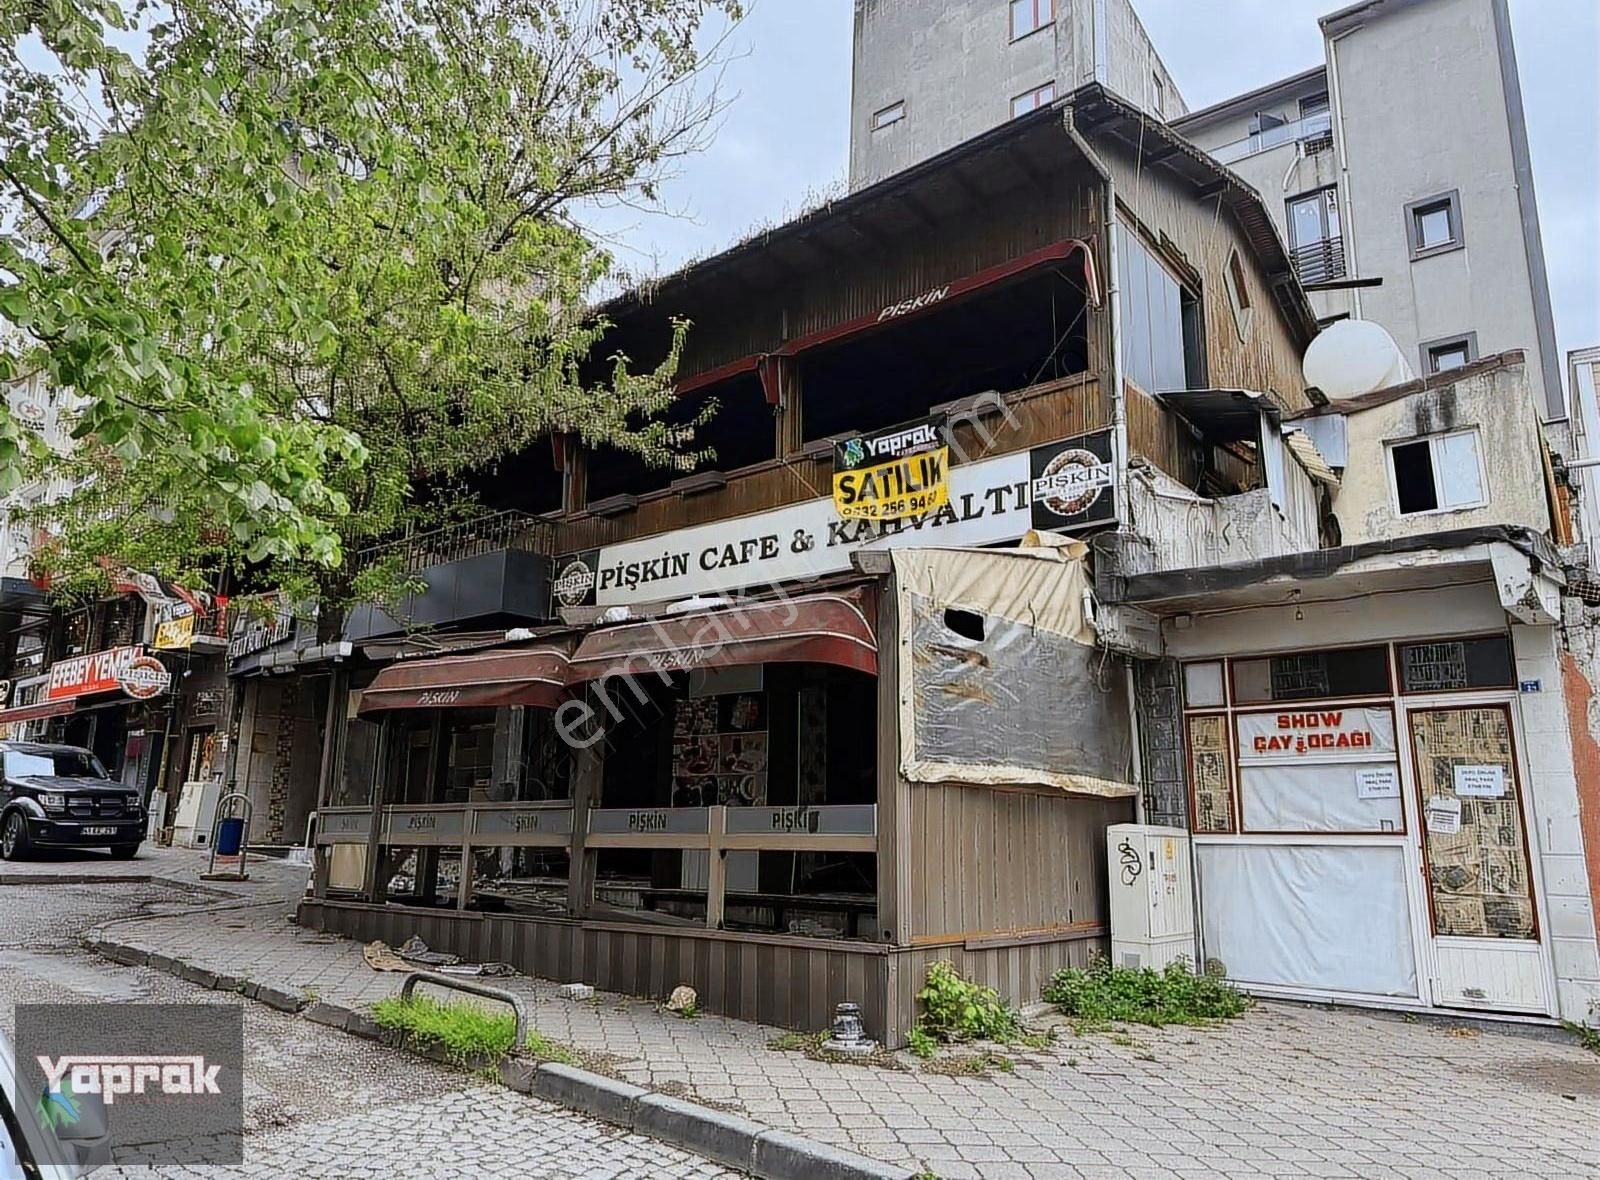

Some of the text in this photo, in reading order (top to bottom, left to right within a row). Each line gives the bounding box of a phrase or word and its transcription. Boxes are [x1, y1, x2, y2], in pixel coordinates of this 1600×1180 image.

[865, 424, 937, 456] Yaprak
[839, 453, 943, 504] SATILIK
[881, 499, 905, 516] 256
[910, 495, 926, 511] 94
[599, 551, 690, 590] PİŞKİN
[699, 535, 779, 571] CAFE
[790, 529, 814, 553] &
[51, 658, 94, 689] EFEBEY
[1277, 712, 1342, 729] SHOW
[1253, 735, 1292, 753] ÇAY
[629, 811, 667, 832] PİŞKİN
[772, 808, 818, 832] PİŞKİ
